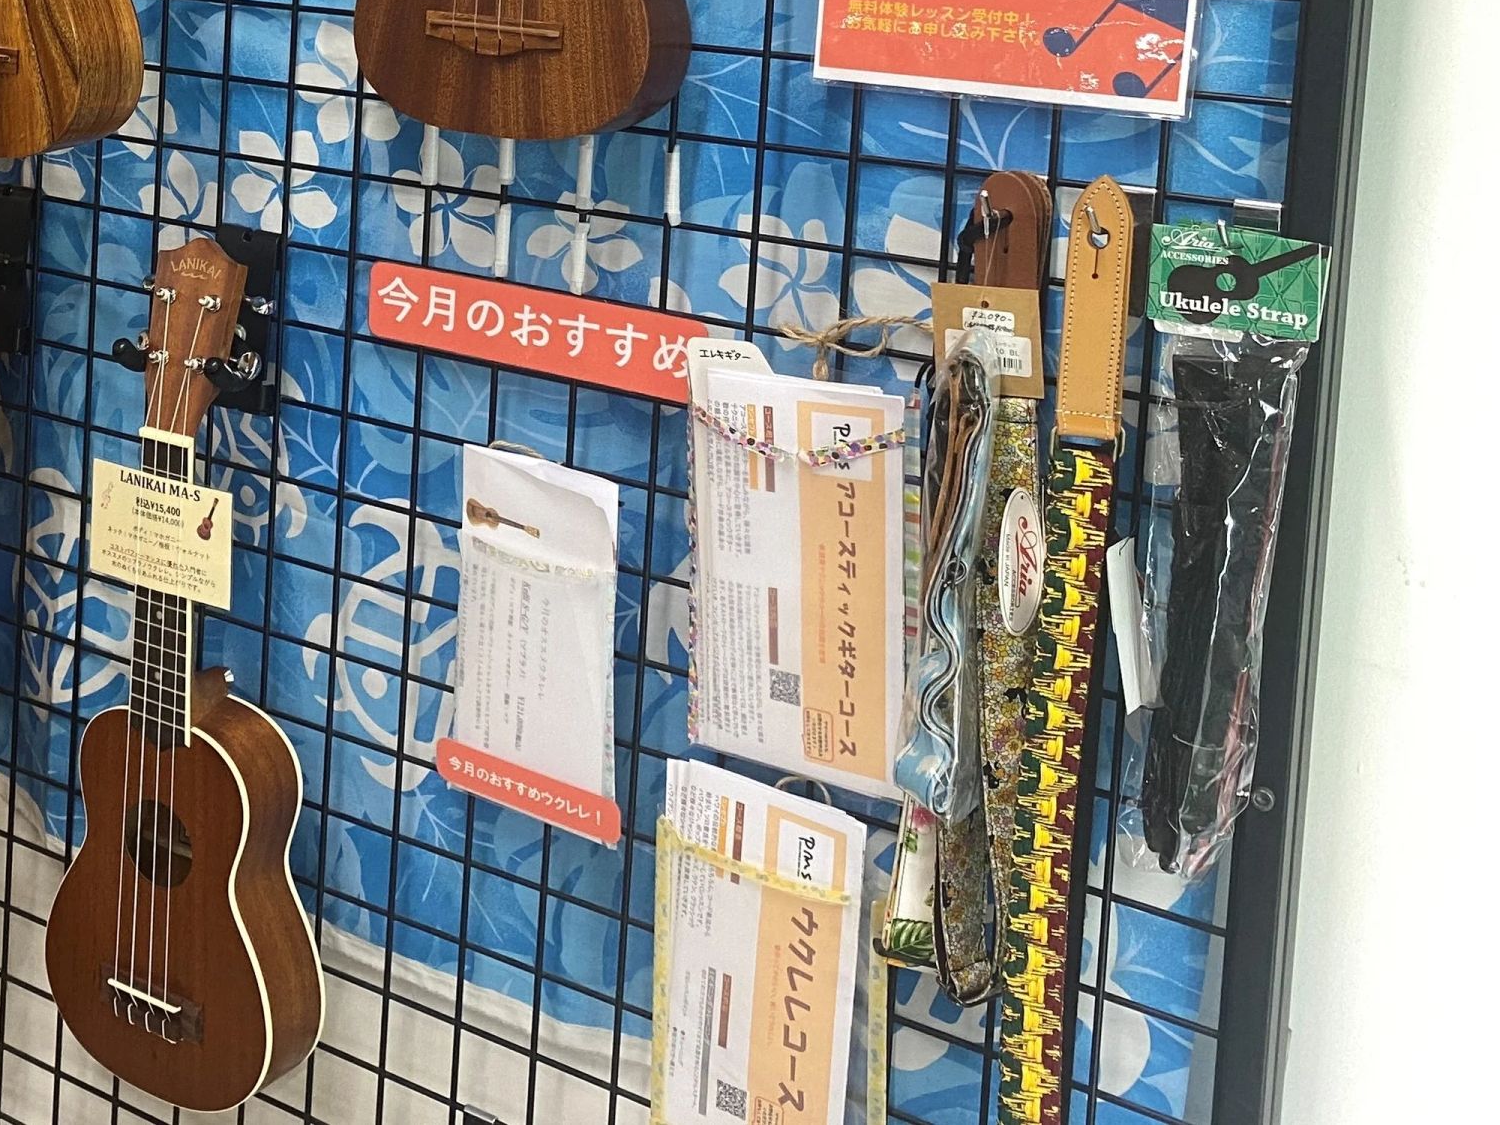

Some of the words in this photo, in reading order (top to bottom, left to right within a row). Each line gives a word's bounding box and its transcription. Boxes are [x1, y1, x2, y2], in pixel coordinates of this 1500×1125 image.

[1160, 250, 1228, 266] ACCESSORIES
[1161, 227, 1221, 251] Aria
[170, 258, 221, 279] LANIKAI
[377, 276, 688, 379] 今月のおすすめ
[1160, 291, 1240, 318] Ukulele
[1246, 301, 1307, 329] Strap
[120, 470, 167, 493] LANIKAI
[169, 484, 200, 502] MA-S
[1018, 516, 1037, 596] Aria
[835, 482, 860, 758] アコースティックギターコース
[448, 756, 600, 827] 今月のおすすめウクレレ！
[778, 907, 819, 1112] ウクレレコース
